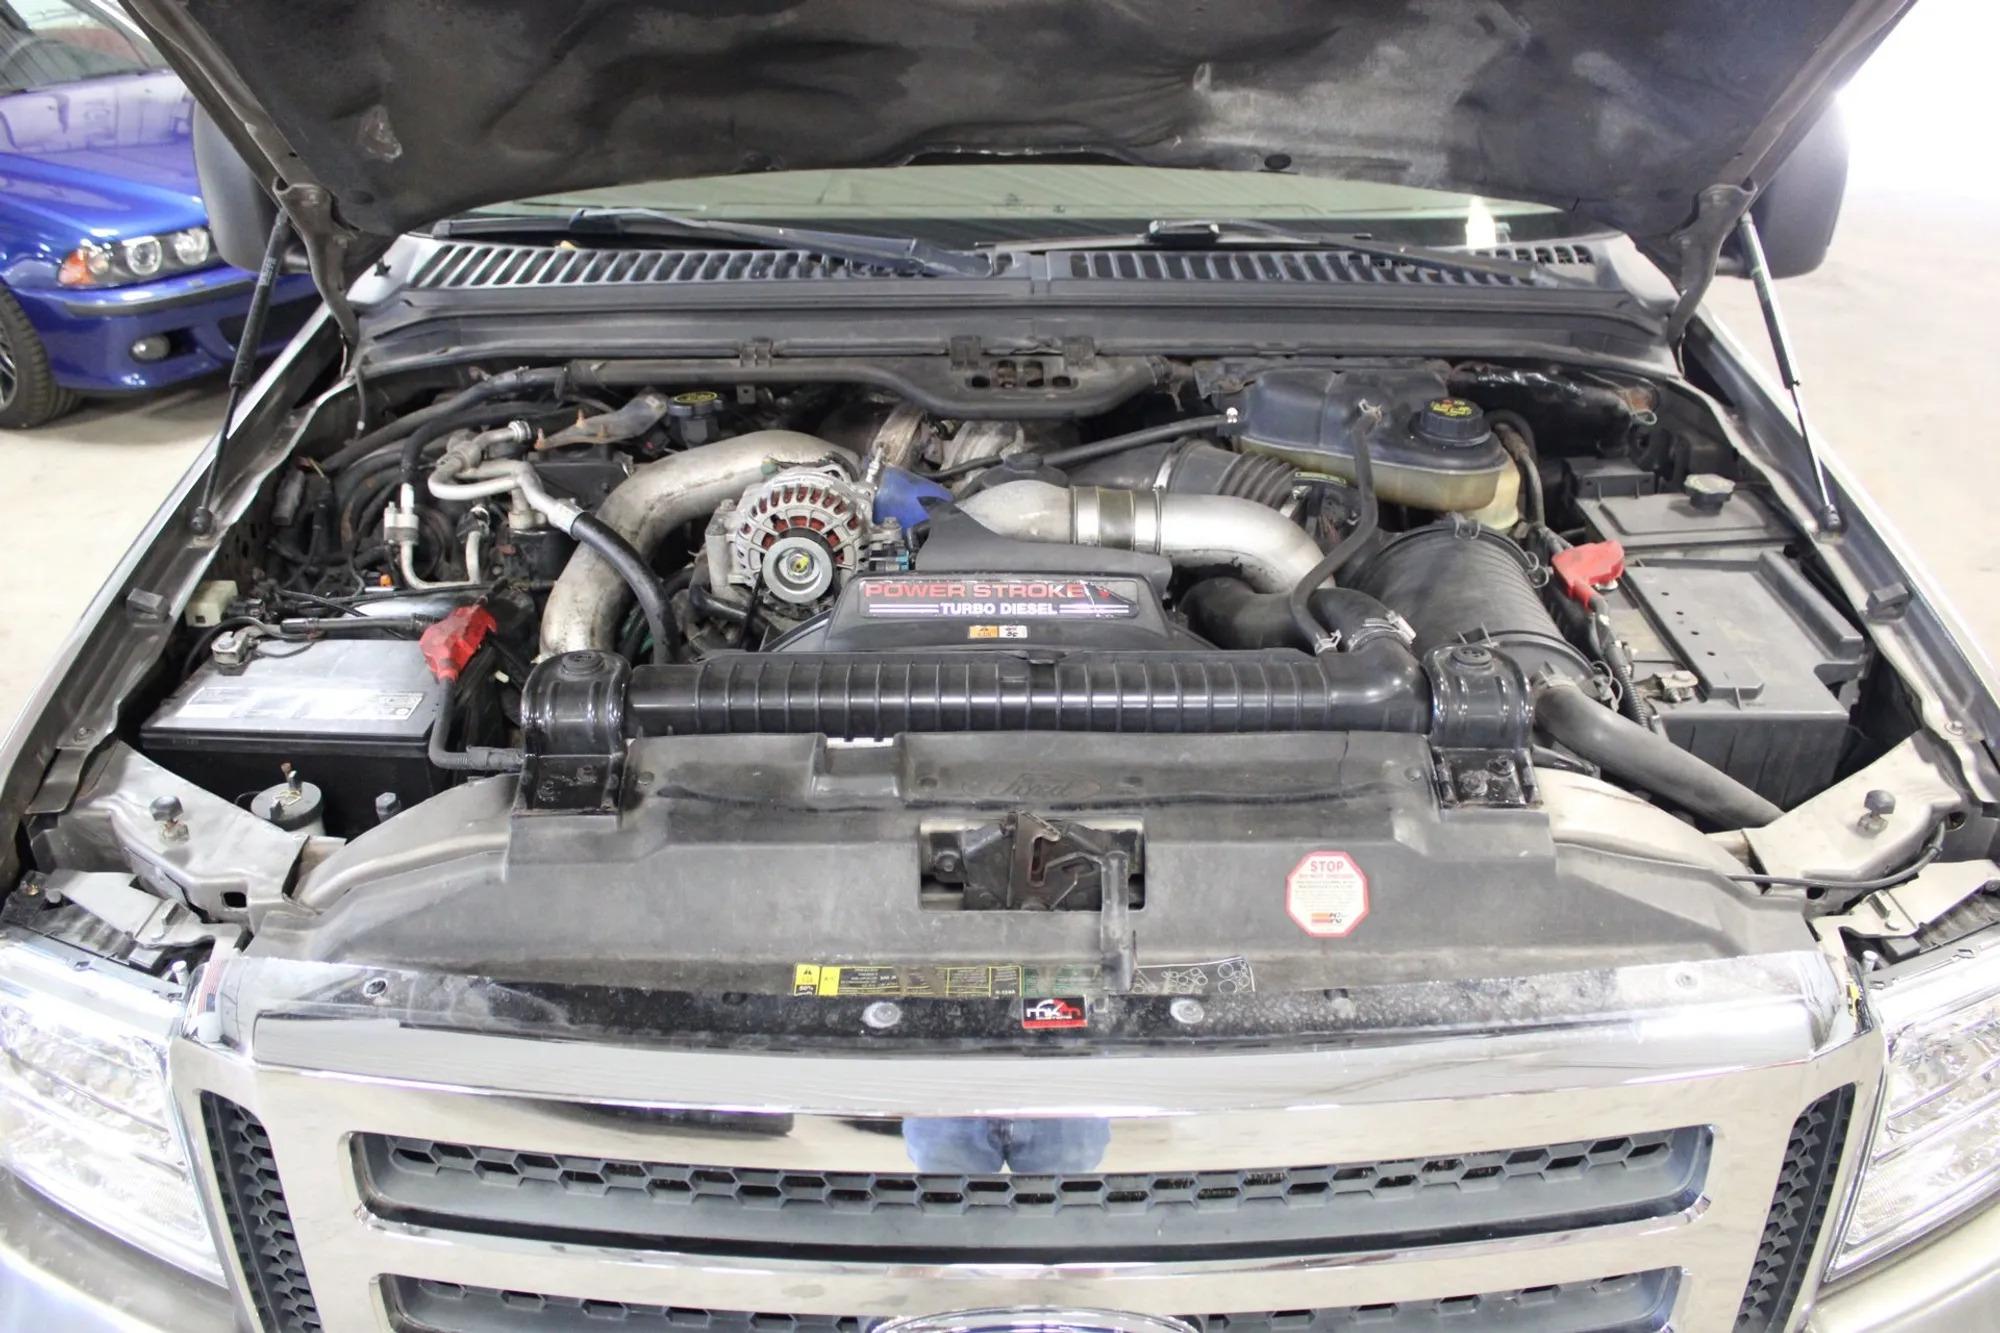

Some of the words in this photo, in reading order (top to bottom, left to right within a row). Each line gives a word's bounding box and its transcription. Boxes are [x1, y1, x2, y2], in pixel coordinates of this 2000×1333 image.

[865, 583, 965, 598] POWER
[973, 583, 1085, 598] STROKE
[940, 602, 996, 615] TURBO
[1000, 602, 1058, 615] DIESEL
[1310, 860, 1344, 872] STOP
